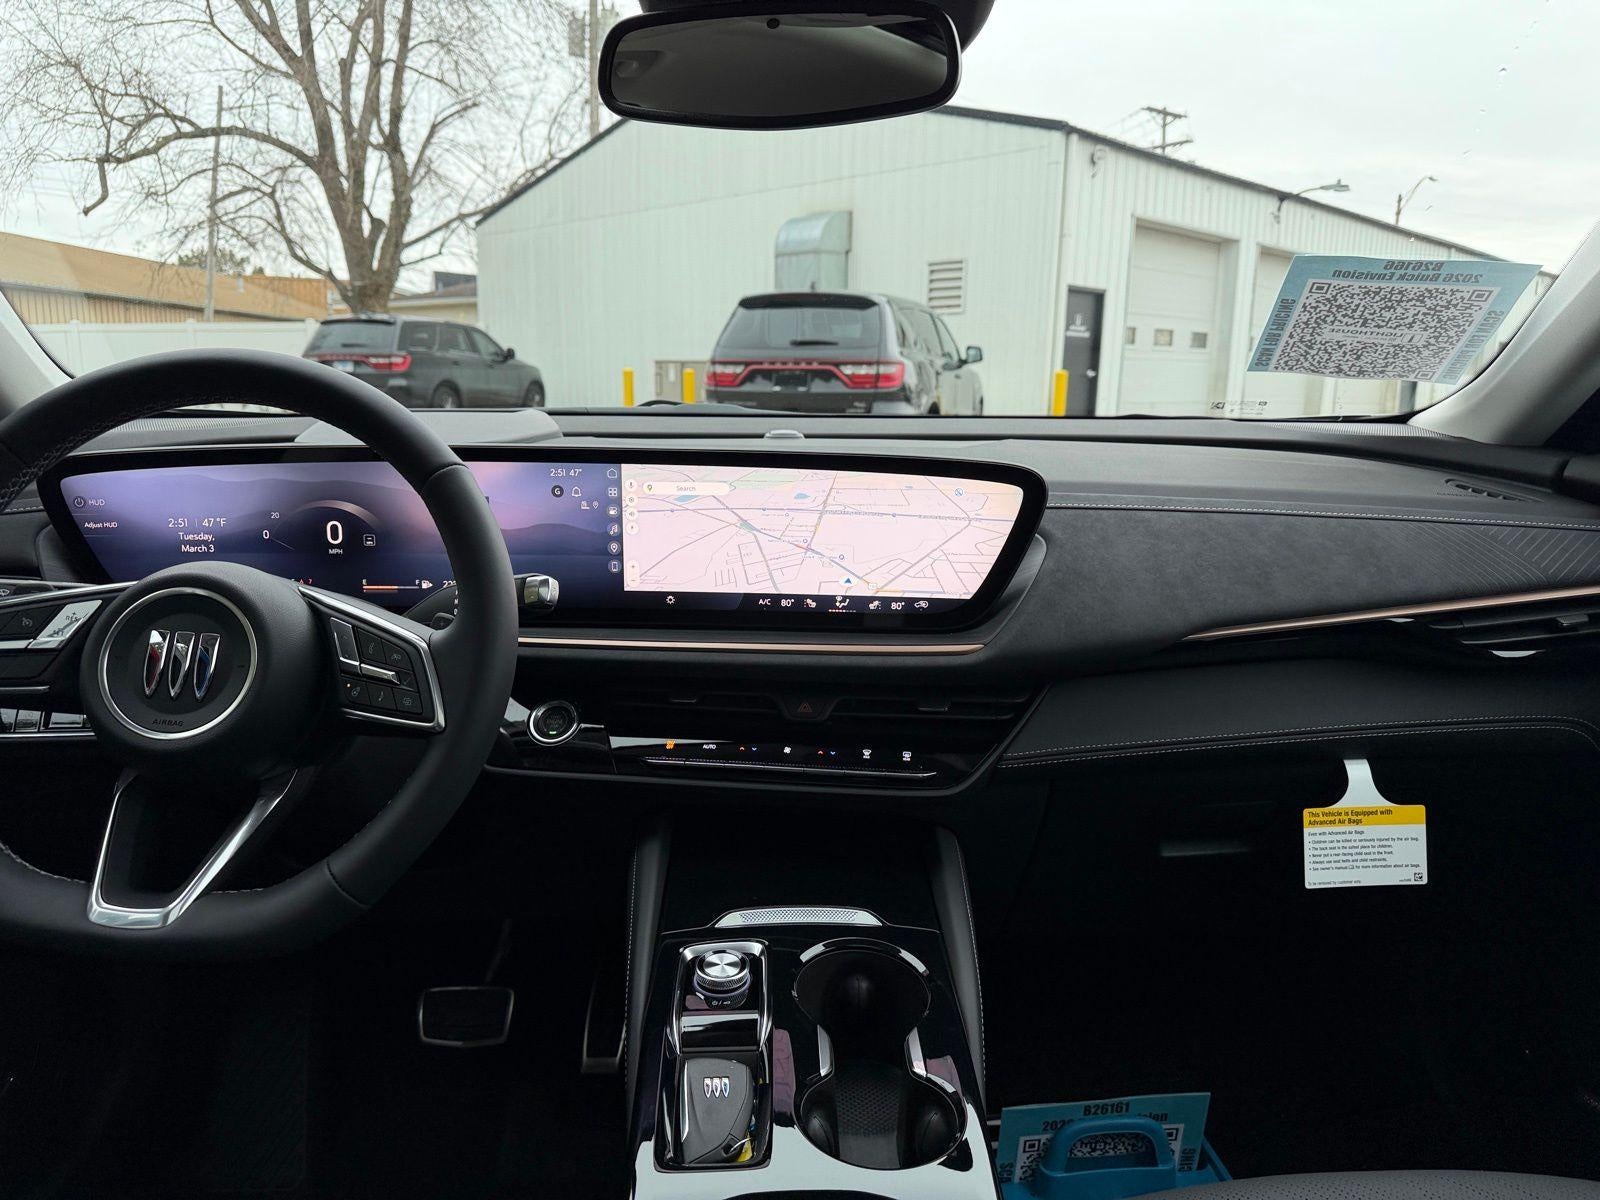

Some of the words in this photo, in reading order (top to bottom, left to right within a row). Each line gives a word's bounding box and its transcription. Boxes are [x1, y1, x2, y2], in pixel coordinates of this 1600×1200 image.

[550, 468, 566, 477] 2:51
[569, 469, 582, 477] 47°
[84, 521, 103, 530] Adjust
[168, 518, 188, 528] 2:51
[202, 518, 214, 527] 47
[178, 532, 215, 542] Tuesday,
[262, 529, 270, 539] 0
[326, 520, 343, 545] 0
[181, 544, 207, 553] March
[209, 544, 215, 553] 3
[780, 598, 795, 607] 80°
[890, 602, 905, 610] 80°
[151, 718, 184, 727] AIRBAG
[1350, 809, 1378, 818] Equipped
[1347, 818, 1363, 826] Bags
[1083, 1101, 1130, 1116] B26161
